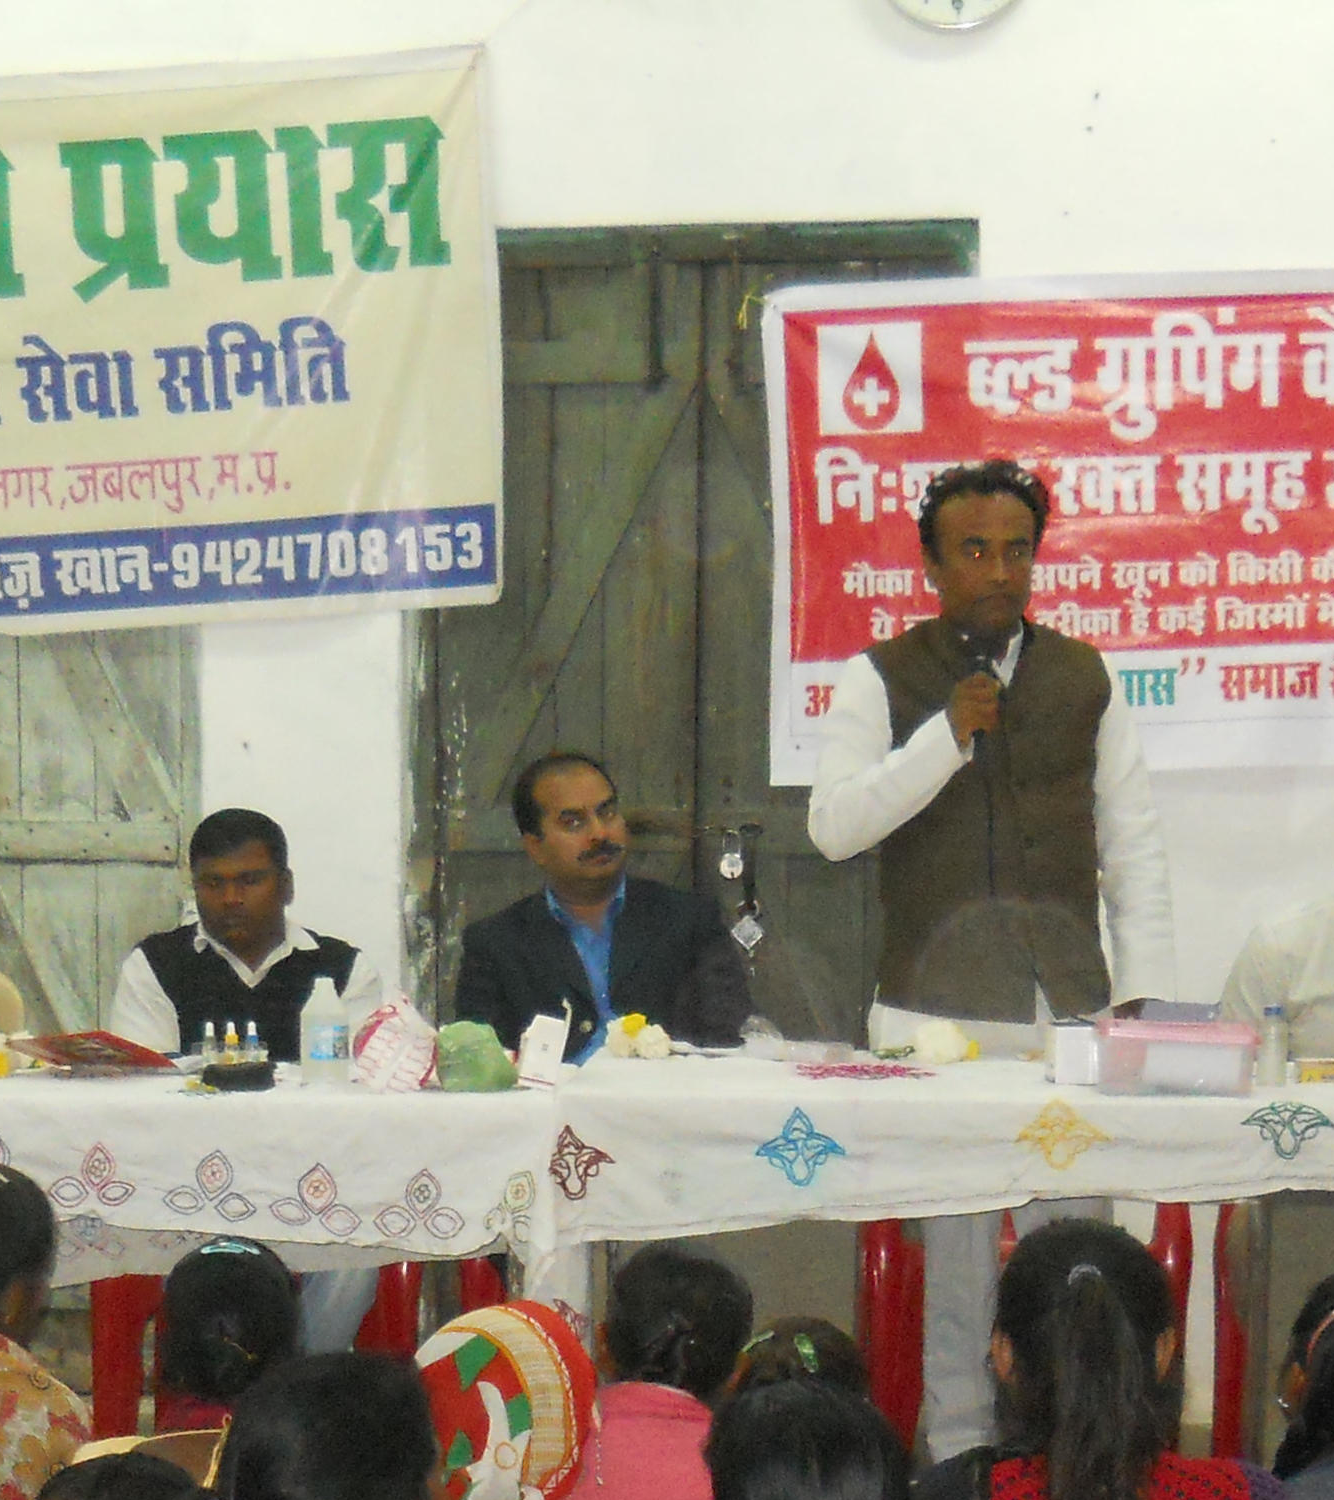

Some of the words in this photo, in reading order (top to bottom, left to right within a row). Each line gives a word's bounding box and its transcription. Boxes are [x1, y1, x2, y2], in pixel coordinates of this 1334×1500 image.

[58, 115, 451, 303] प्रयास
[15, 334, 140, 424] सेवा
[153, 315, 351, 415] समिति
[1094, 308, 1287, 441] ग्रुपिंग
[1052, 453, 1164, 516] रक्त
[1175, 448, 1314, 534] समूह
[842, 561, 915, 600] मौका
[1030, 554, 1104, 592] अपने
[1110, 559, 1172, 605] खून
[1178, 550, 1219, 587] को
[1226, 549, 1304, 588] किसी
[870, 606, 896, 641] ये
[1123, 587, 1153, 635] है
[1157, 597, 1207, 637] कई
[1219, 660, 1321, 702] समाज
